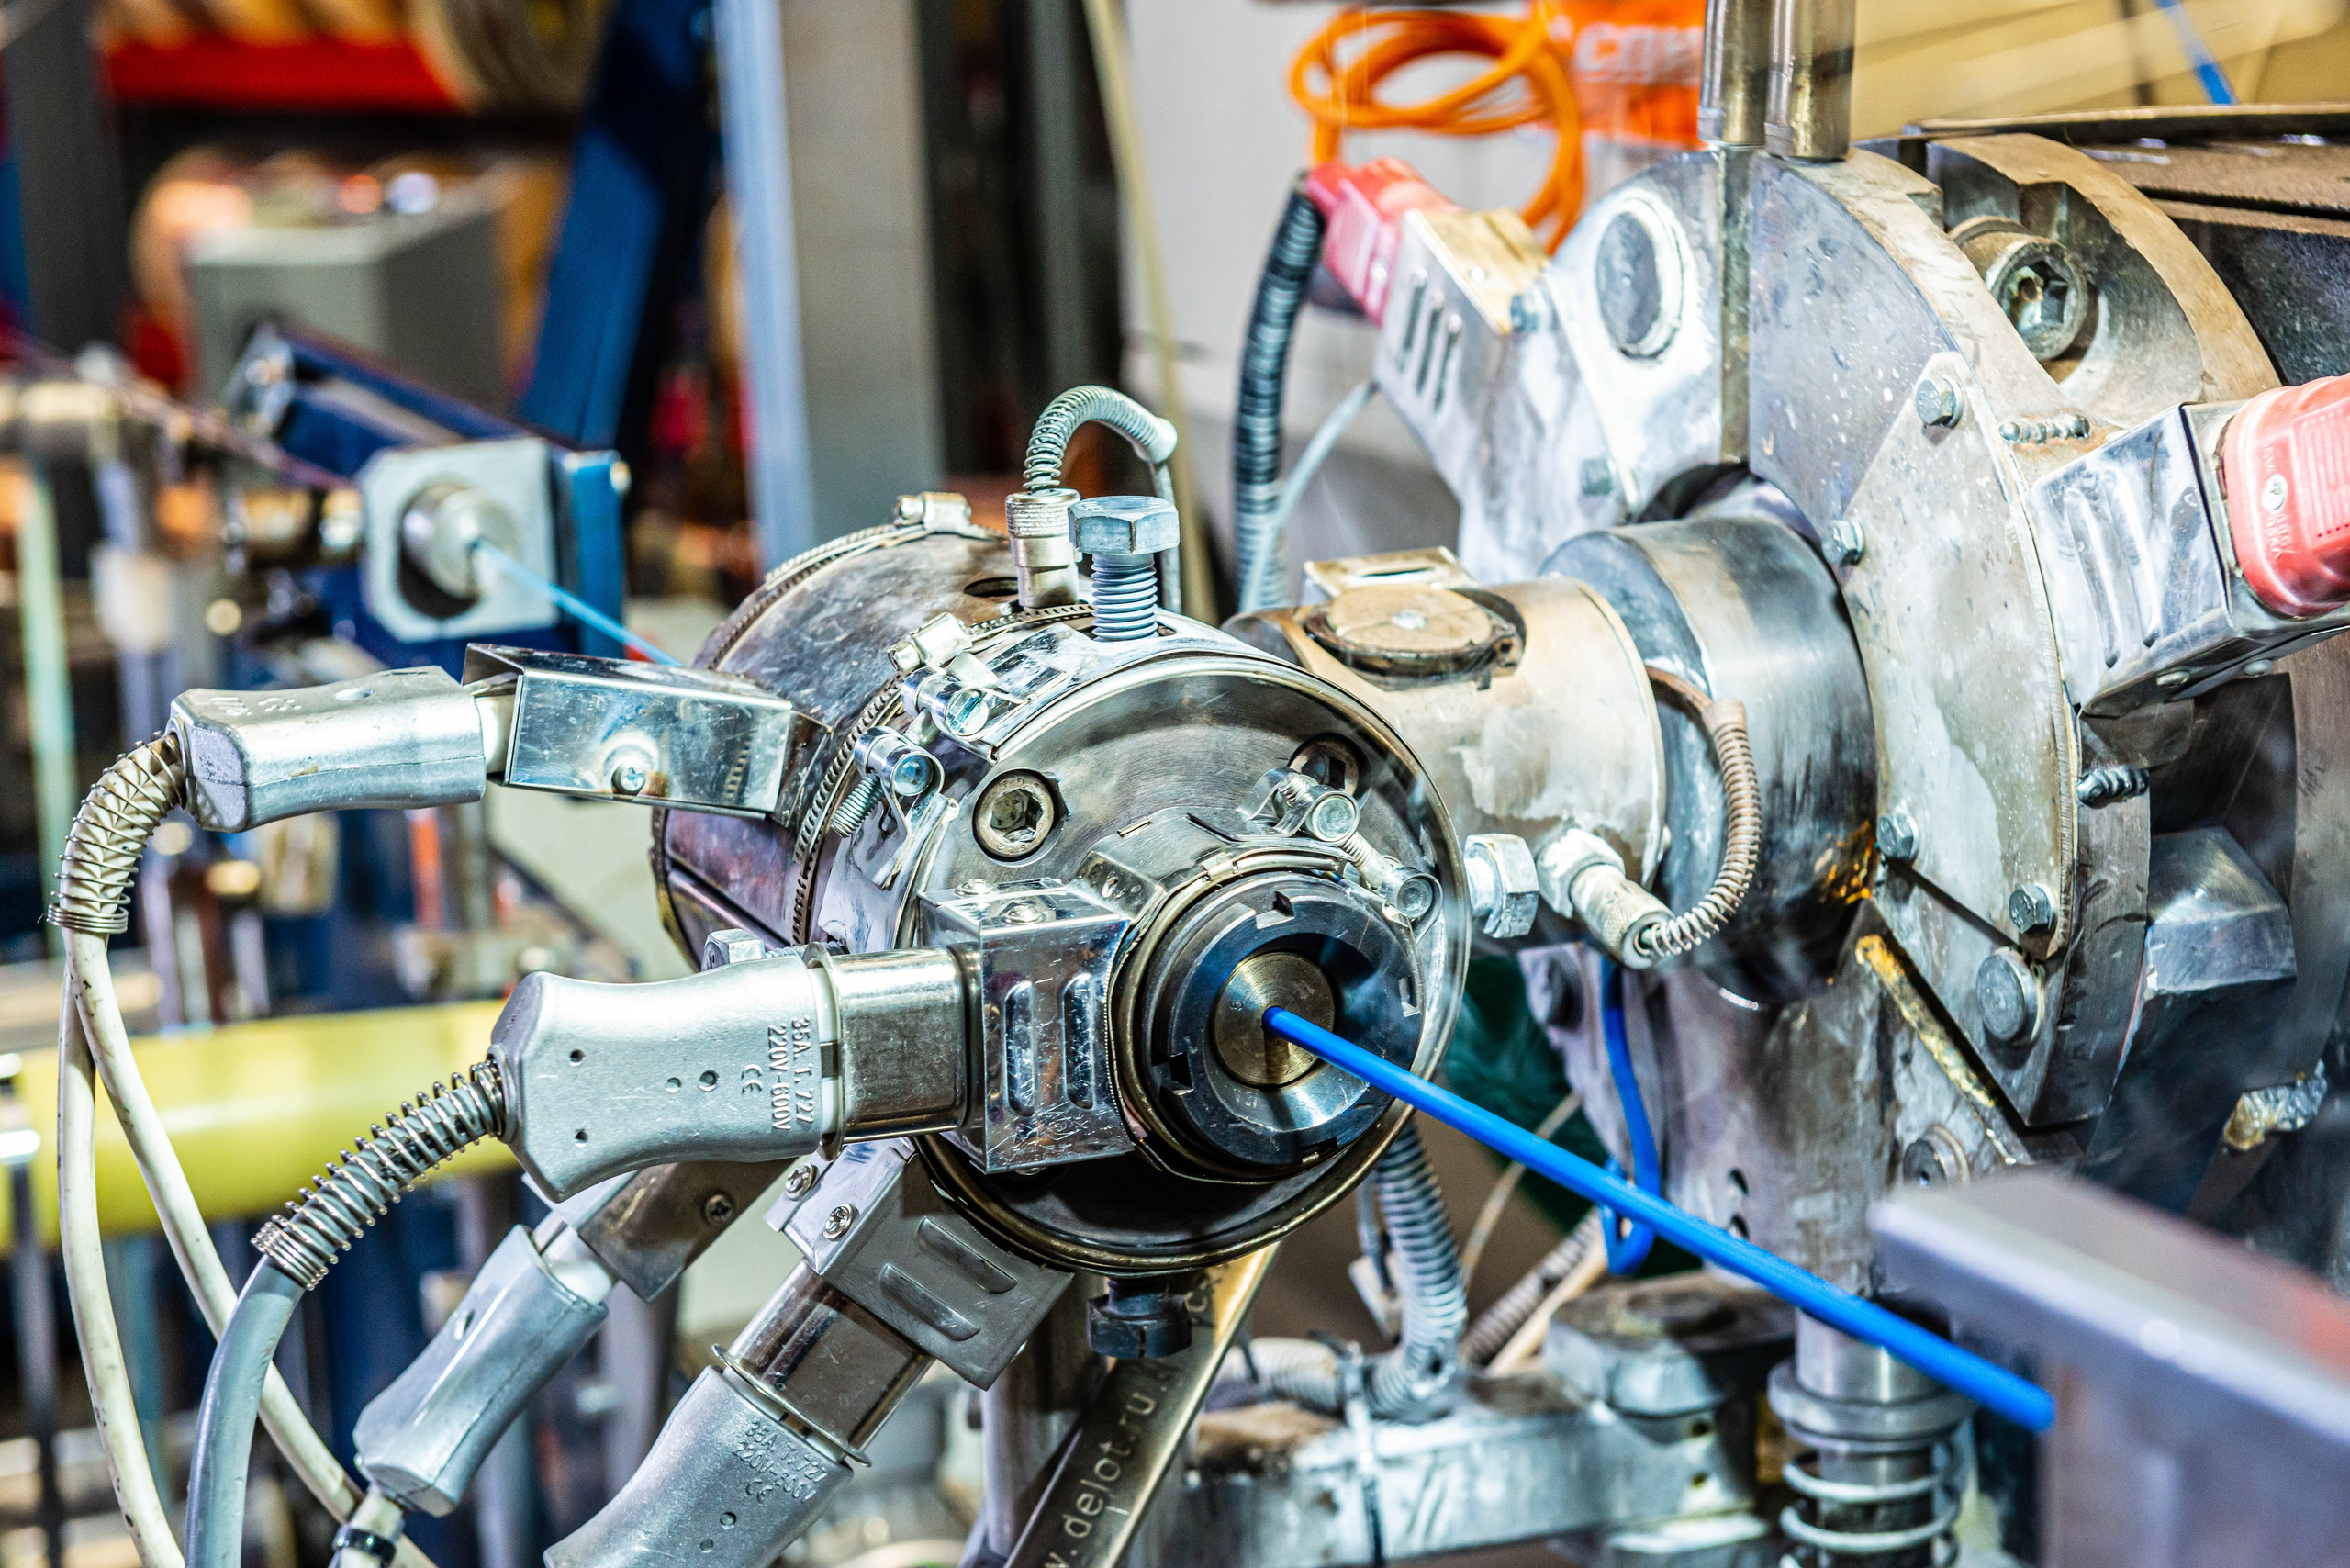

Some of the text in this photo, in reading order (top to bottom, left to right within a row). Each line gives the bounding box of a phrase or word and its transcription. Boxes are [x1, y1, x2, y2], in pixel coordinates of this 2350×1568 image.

[741, 1063, 763, 1095] CE
[767, 1023, 792, 1130] 220V-600V
[795, 1088, 814, 1123] 727
[732, 1440, 817, 1503] 220V-600V
[797, 1454, 828, 1483] 727
